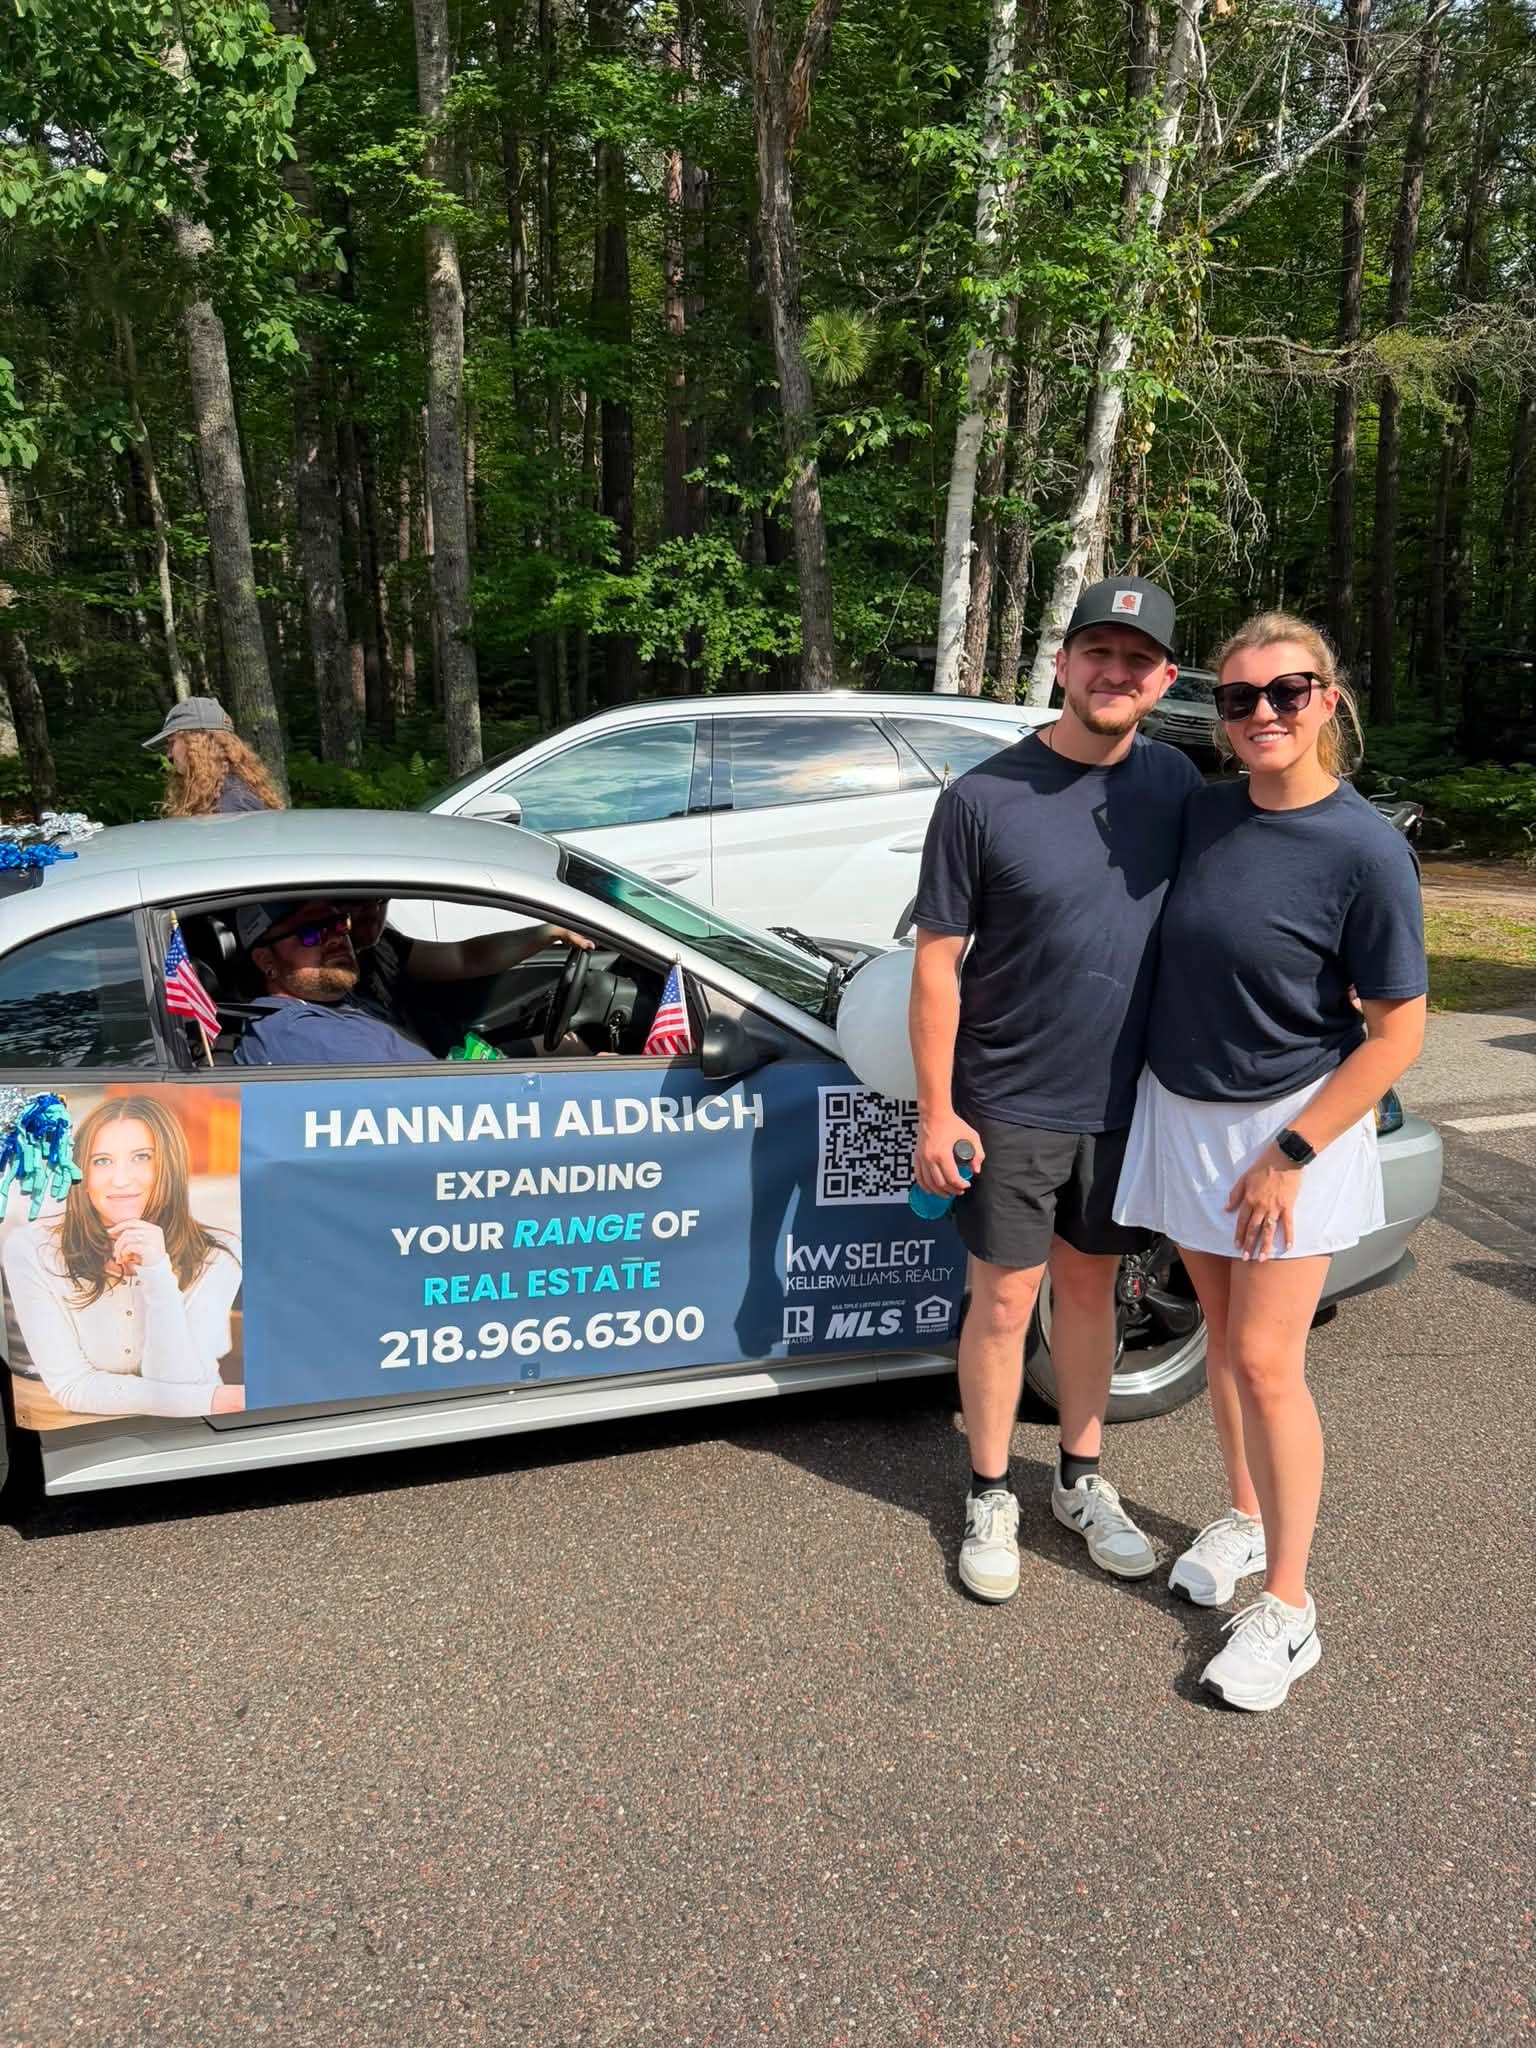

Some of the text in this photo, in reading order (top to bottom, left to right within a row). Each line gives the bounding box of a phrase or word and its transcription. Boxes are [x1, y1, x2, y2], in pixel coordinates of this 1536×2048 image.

[303, 1093, 764, 1149] HANNAH ALDRICH
[436, 1161, 663, 1201] EXPANDING
[391, 1209, 700, 1256] YOUR RANGE OF
[845, 1239, 936, 1270] SELECT
[424, 1260, 661, 1306] REAL ESTATE
[905, 1266, 955, 1283] REALTY
[379, 1306, 705, 1370] 218.966.6300
